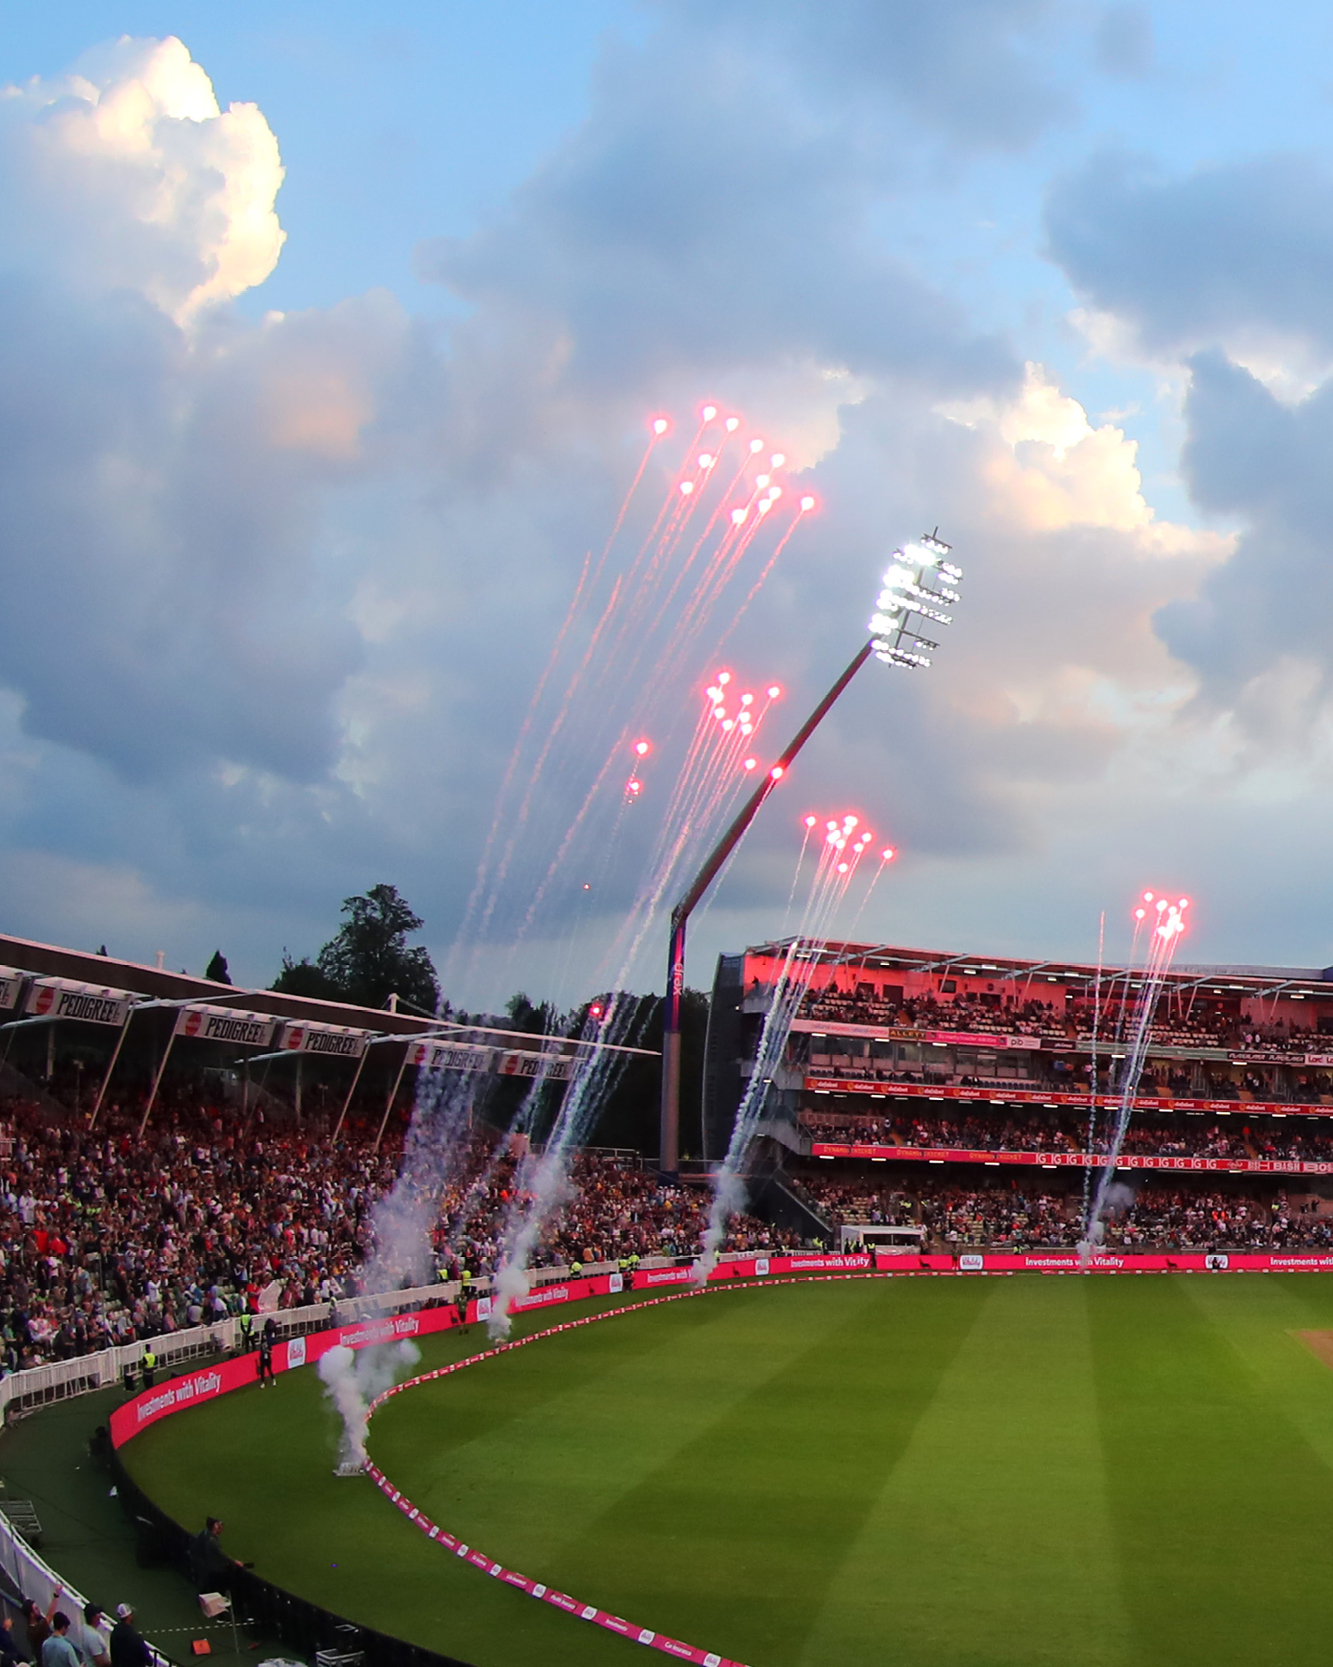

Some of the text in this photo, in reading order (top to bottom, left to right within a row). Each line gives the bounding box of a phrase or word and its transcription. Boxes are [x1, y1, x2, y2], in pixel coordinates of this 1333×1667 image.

[56, 993, 115, 1023] PEDIGREE
[205, 1017, 258, 1043] PEDIGREE
[890, 1029, 926, 1039] ALLETT
[305, 1032, 354, 1054] PEDIGREE
[826, 1257, 844, 1266] with
[1025, 1257, 1073, 1266] Investments
[1094, 1257, 1124, 1267] Vitality
[1270, 1257, 1318, 1266] Investments
[395, 1317, 419, 1334] Vitality
[137, 1372, 221, 1422] Investments with Vitality
